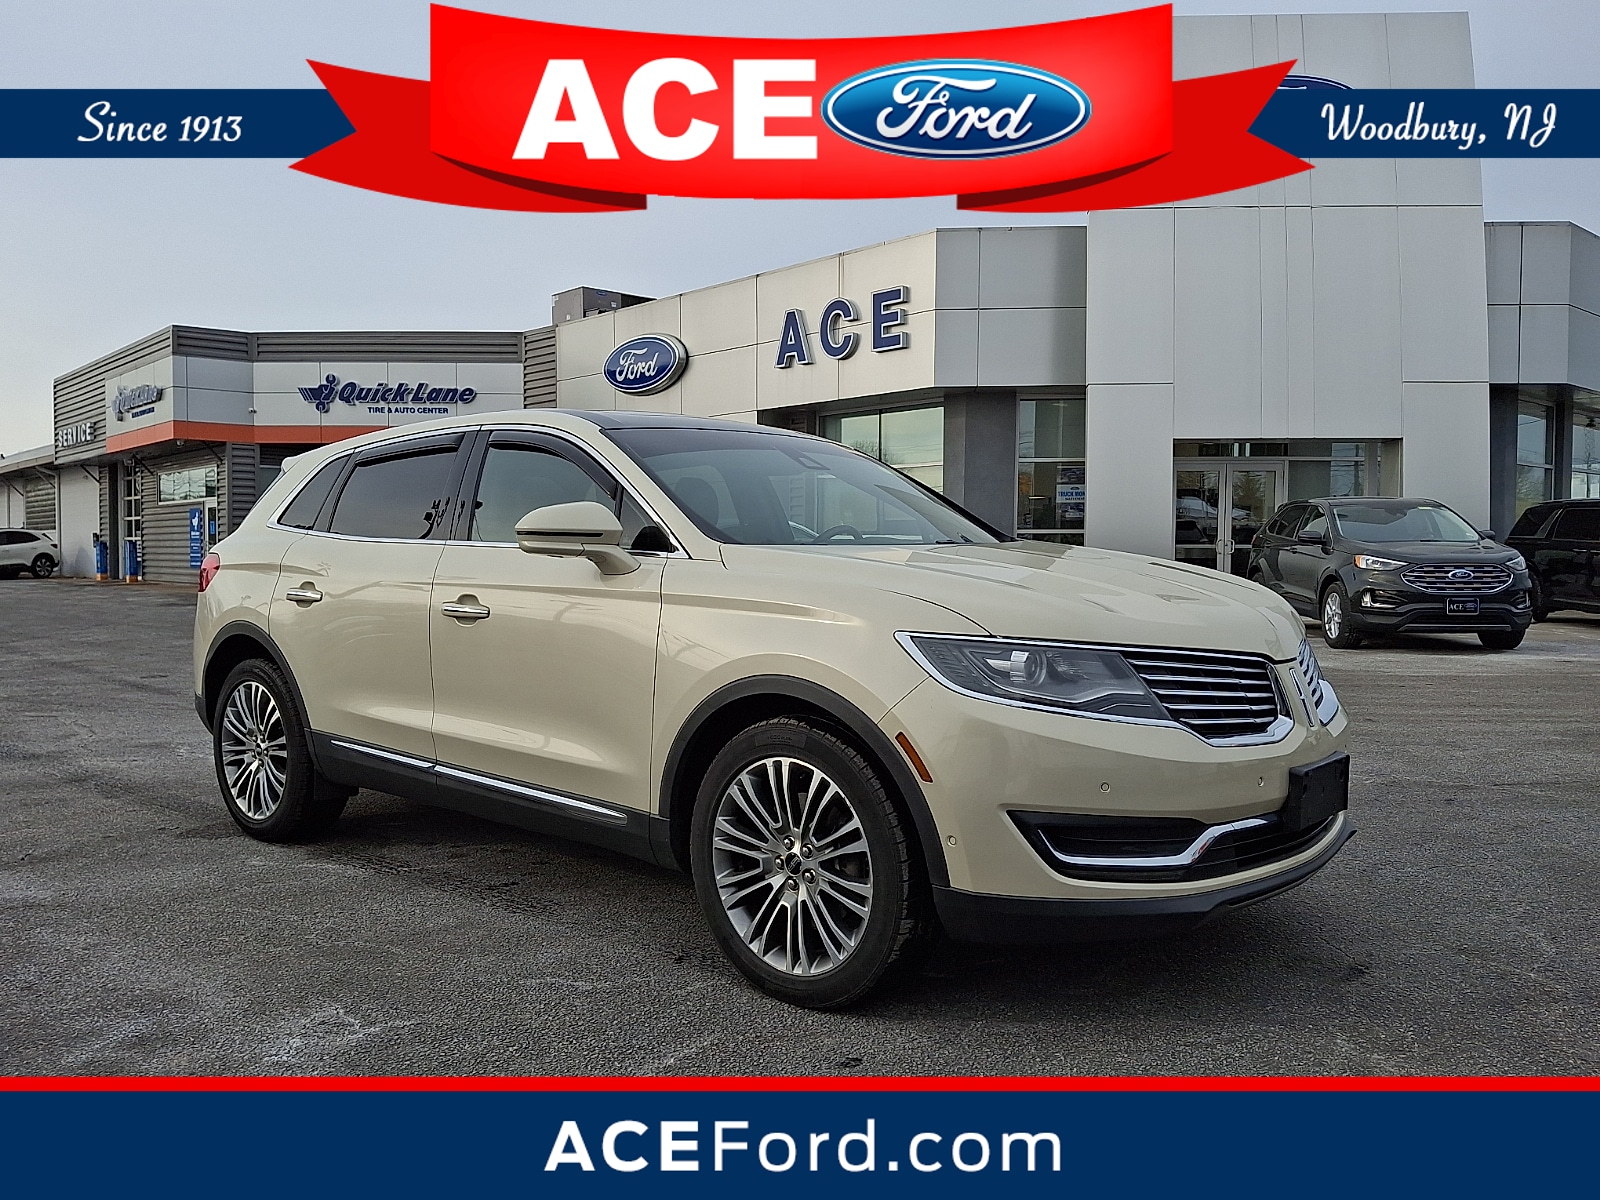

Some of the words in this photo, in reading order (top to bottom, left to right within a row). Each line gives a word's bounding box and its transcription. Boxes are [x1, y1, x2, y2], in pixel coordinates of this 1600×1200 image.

[774, 285, 909, 369] ACE
[615, 347, 660, 382] Ford
[367, 406, 386, 414] TIRE
[394, 406, 416, 414] AUTO
[416, 406, 449, 414] CENTER
[58, 422, 93, 448] SERVICE
[1448, 603, 1464, 611] ACE
